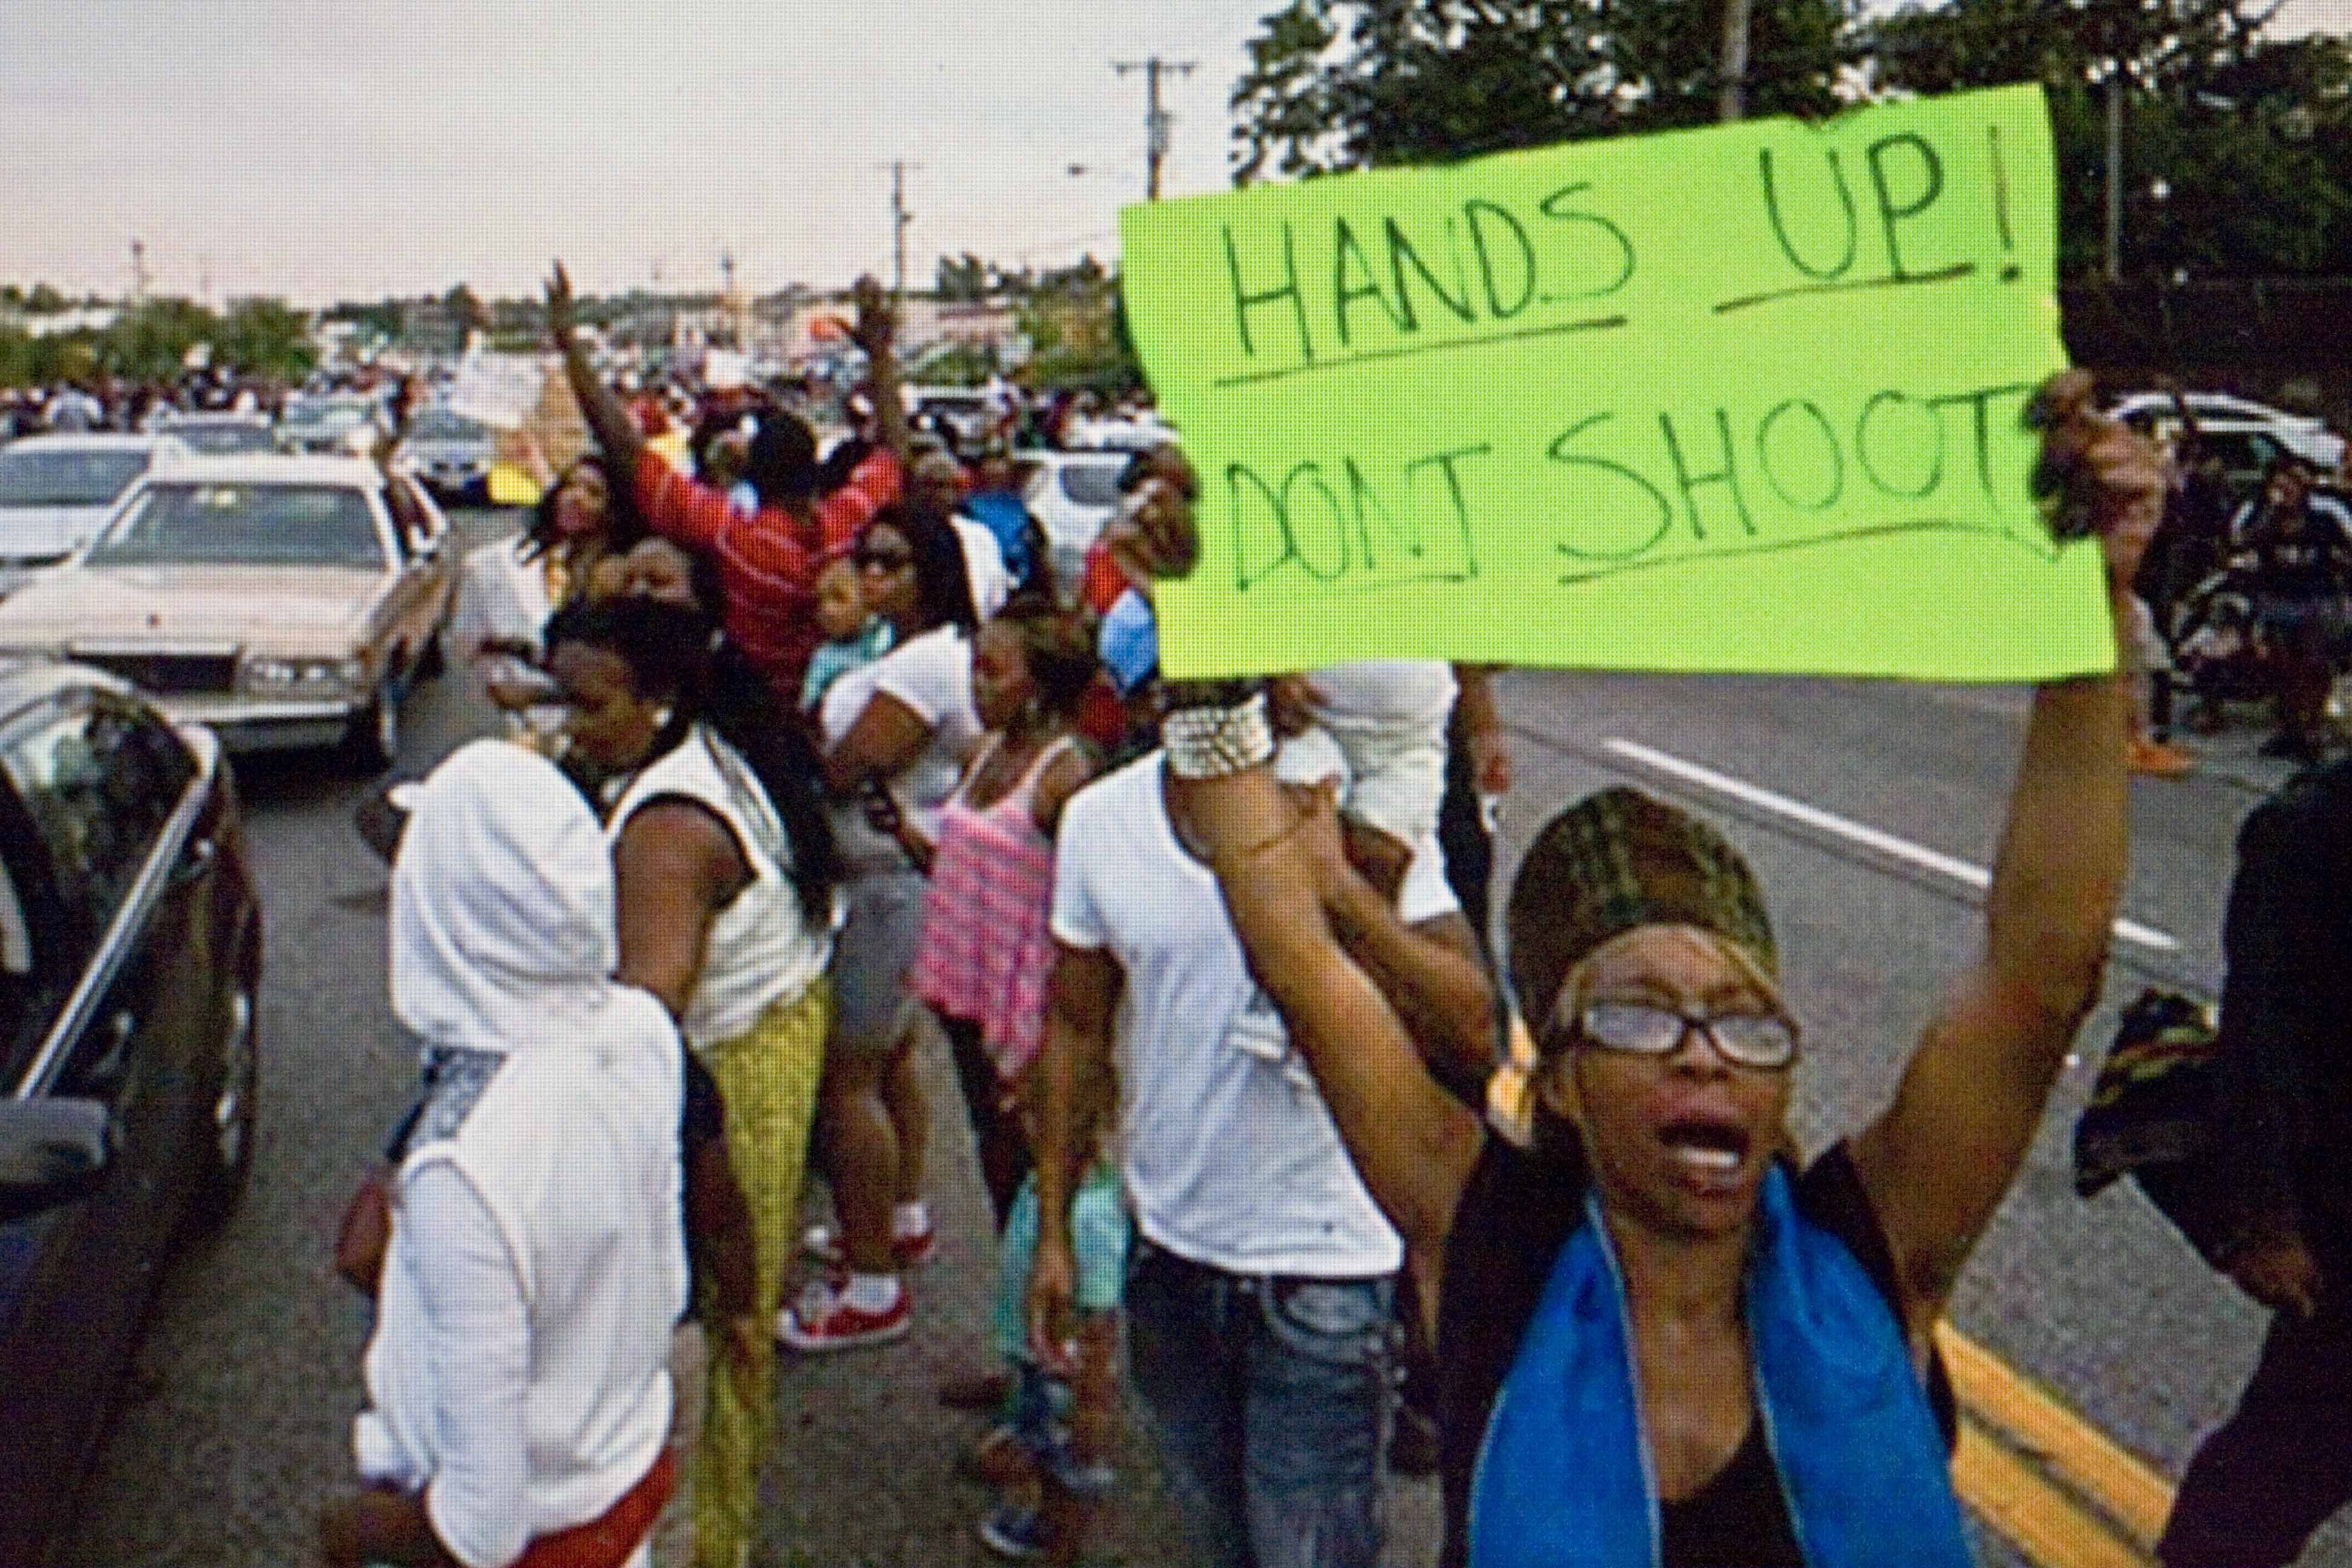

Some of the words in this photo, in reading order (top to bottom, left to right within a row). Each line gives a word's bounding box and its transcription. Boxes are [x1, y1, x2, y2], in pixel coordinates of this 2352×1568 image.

[1222, 180, 1636, 364] HANDS
[1759, 124, 2022, 283] UP!
[1225, 443, 1492, 592] DONT
[1546, 382, 2043, 561] SHOOT
